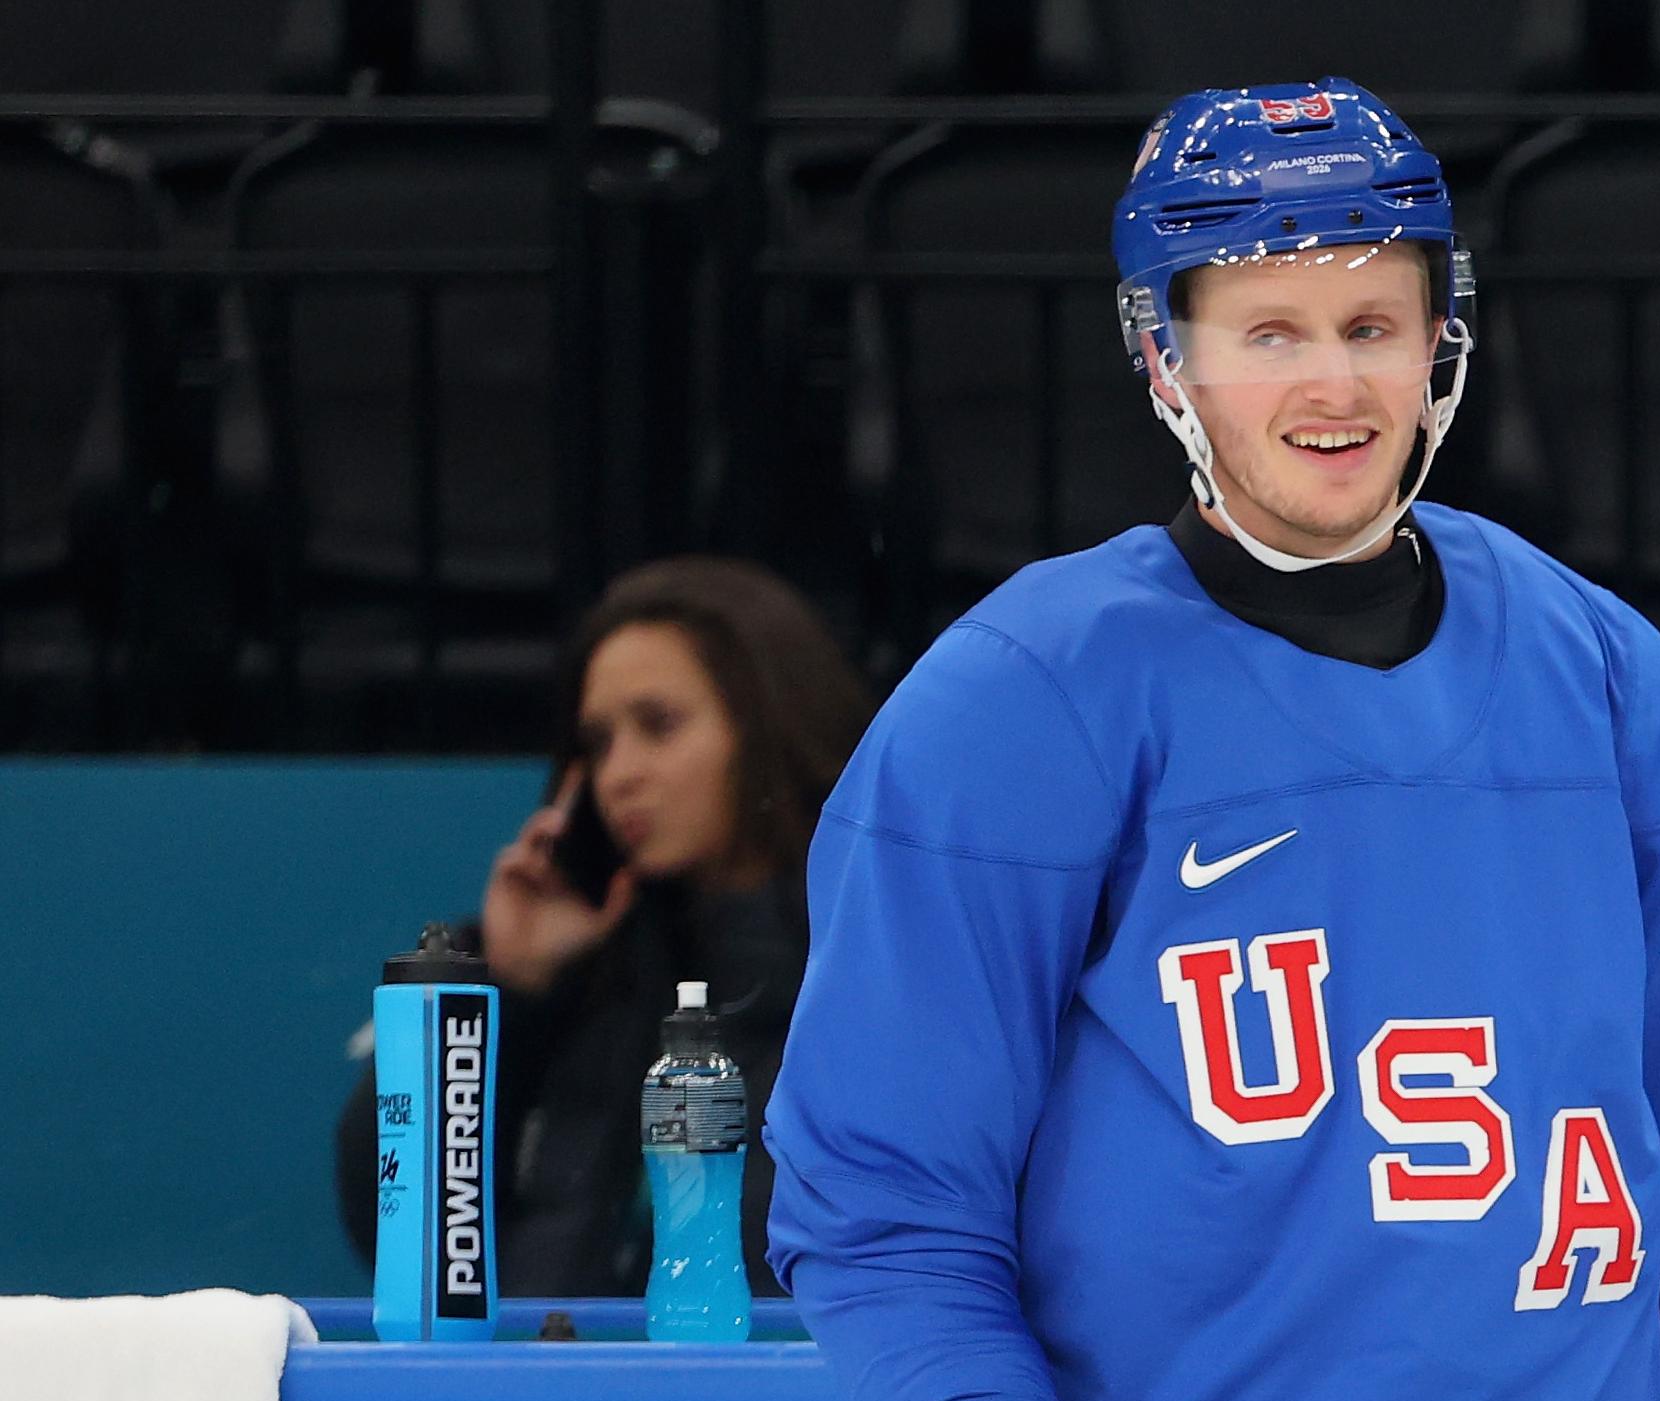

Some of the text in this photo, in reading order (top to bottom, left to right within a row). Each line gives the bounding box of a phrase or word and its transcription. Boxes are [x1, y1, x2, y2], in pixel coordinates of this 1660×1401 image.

[1267, 153, 1367, 171] MILANO CORTINA
[1306, 164, 1331, 175] 2026
[446, 1014, 482, 1296] POWERADE
[1158, 928, 1645, 1311] USA
